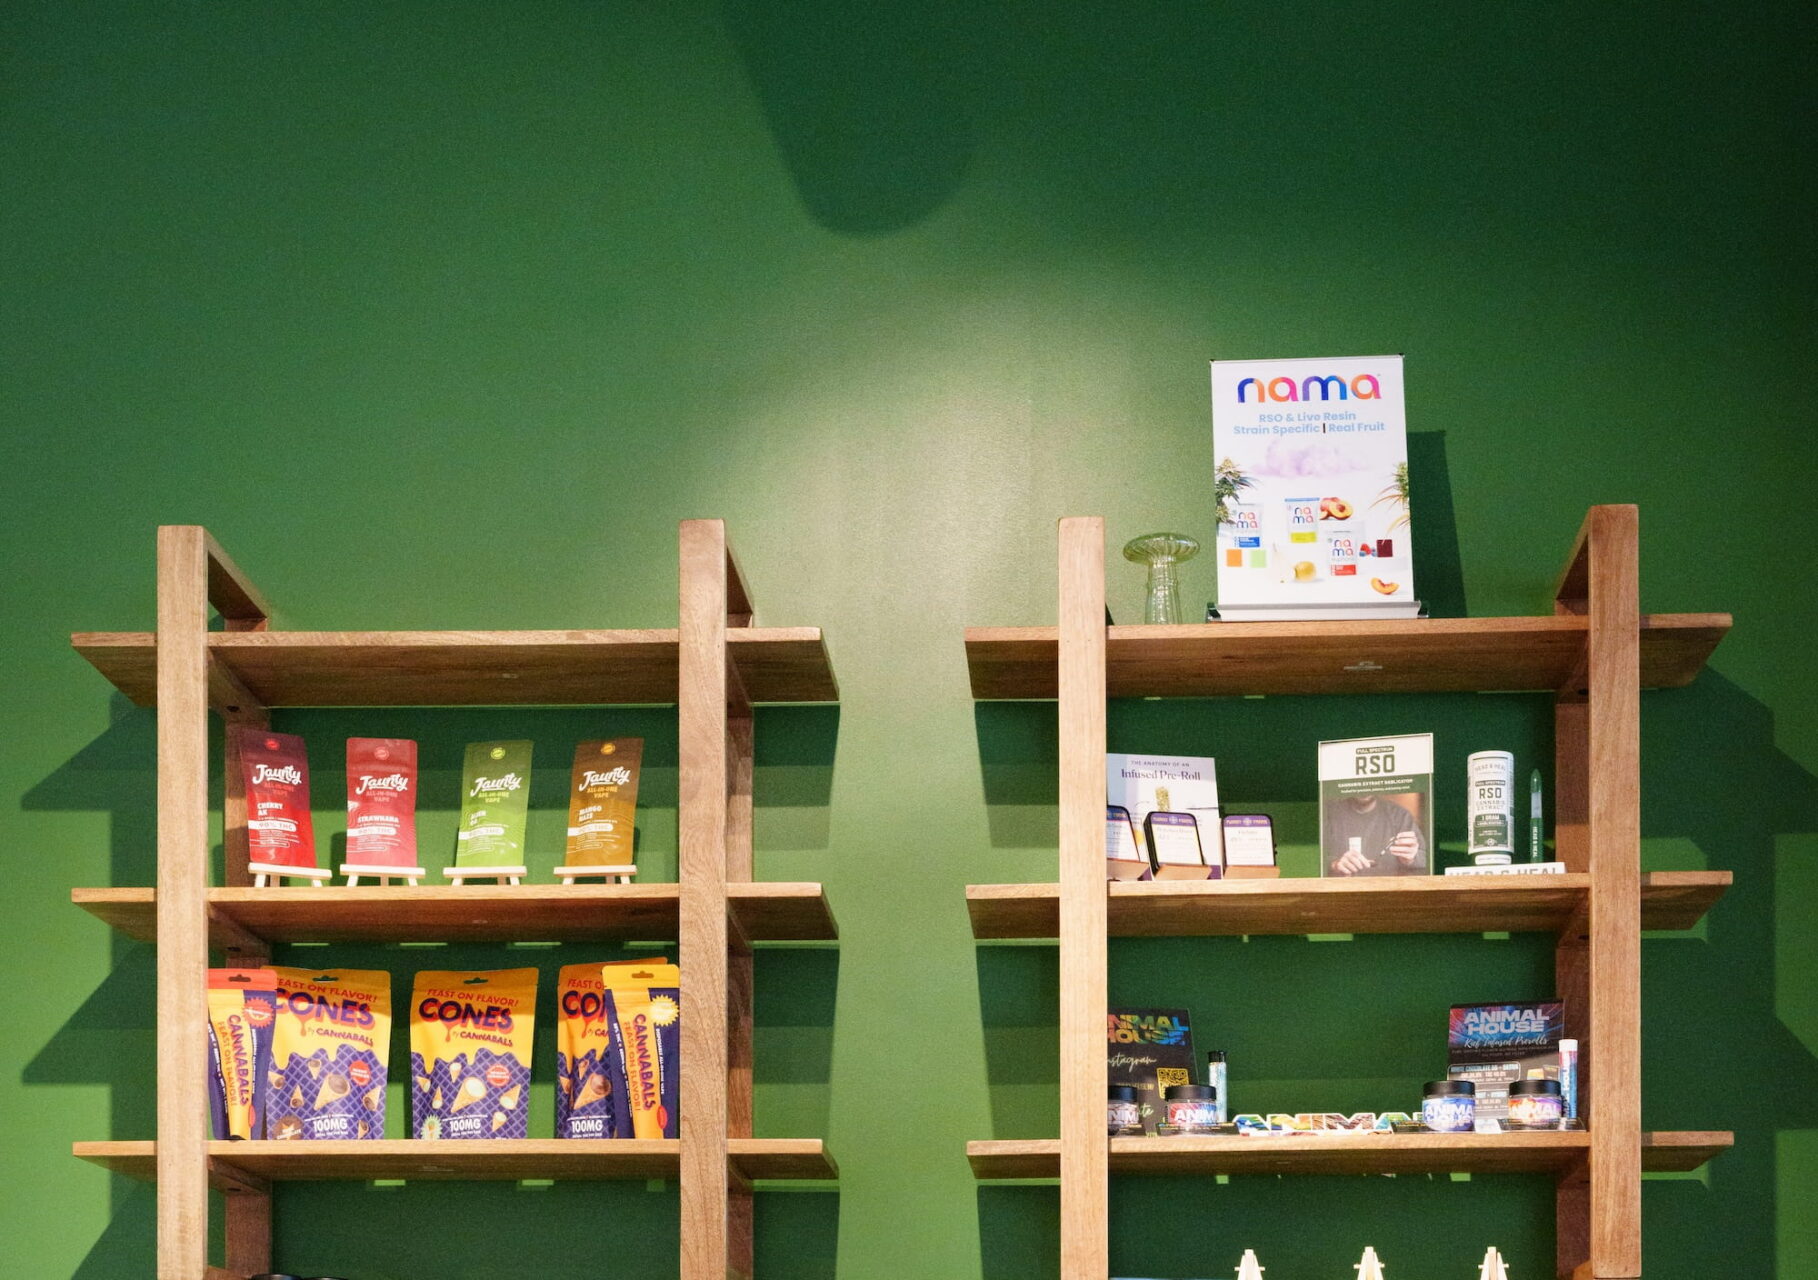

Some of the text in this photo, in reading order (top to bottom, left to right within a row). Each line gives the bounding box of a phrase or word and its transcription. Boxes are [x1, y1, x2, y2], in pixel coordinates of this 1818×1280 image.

[1237, 374, 1382, 403] nama
[1259, 411, 1356, 423] RSO & Live Resin
[1233, 421, 1385, 436] Strain Specific Real Fruit
[1355, 754, 1395, 775] RSO
[252, 764, 302, 786] Jaunty
[578, 766, 631, 791] Jaunty
[1121, 768, 1201, 780] Infused Pre-Roll
[355, 773, 409, 795] Jaunty
[470, 773, 522, 797] Jaunty
[1479, 788, 1502, 799] RSO
[277, 978, 377, 1002] EAST ON FLAVOR!
[427, 989, 519, 1007] FEAST ON FLAVOR!
[419, 998, 513, 1032] CONES
[1464, 1009, 1550, 1024] ANIMAL
[1468, 1020, 1545, 1035] HOUSE
[460, 1031, 513, 1047] CANNABALS
[228, 1014, 250, 1106] CANNABALS
[633, 1013, 656, 1111] CANNABALS
[1107, 1051, 1157, 1073] nstagram
[1174, 1109, 1215, 1122] ANIM
[1233, 1112, 1424, 1131] ANIMA
[313, 1118, 348, 1132] 100MG
[449, 1118, 481, 1132] 100MG
[571, 1119, 603, 1133] 100MG
